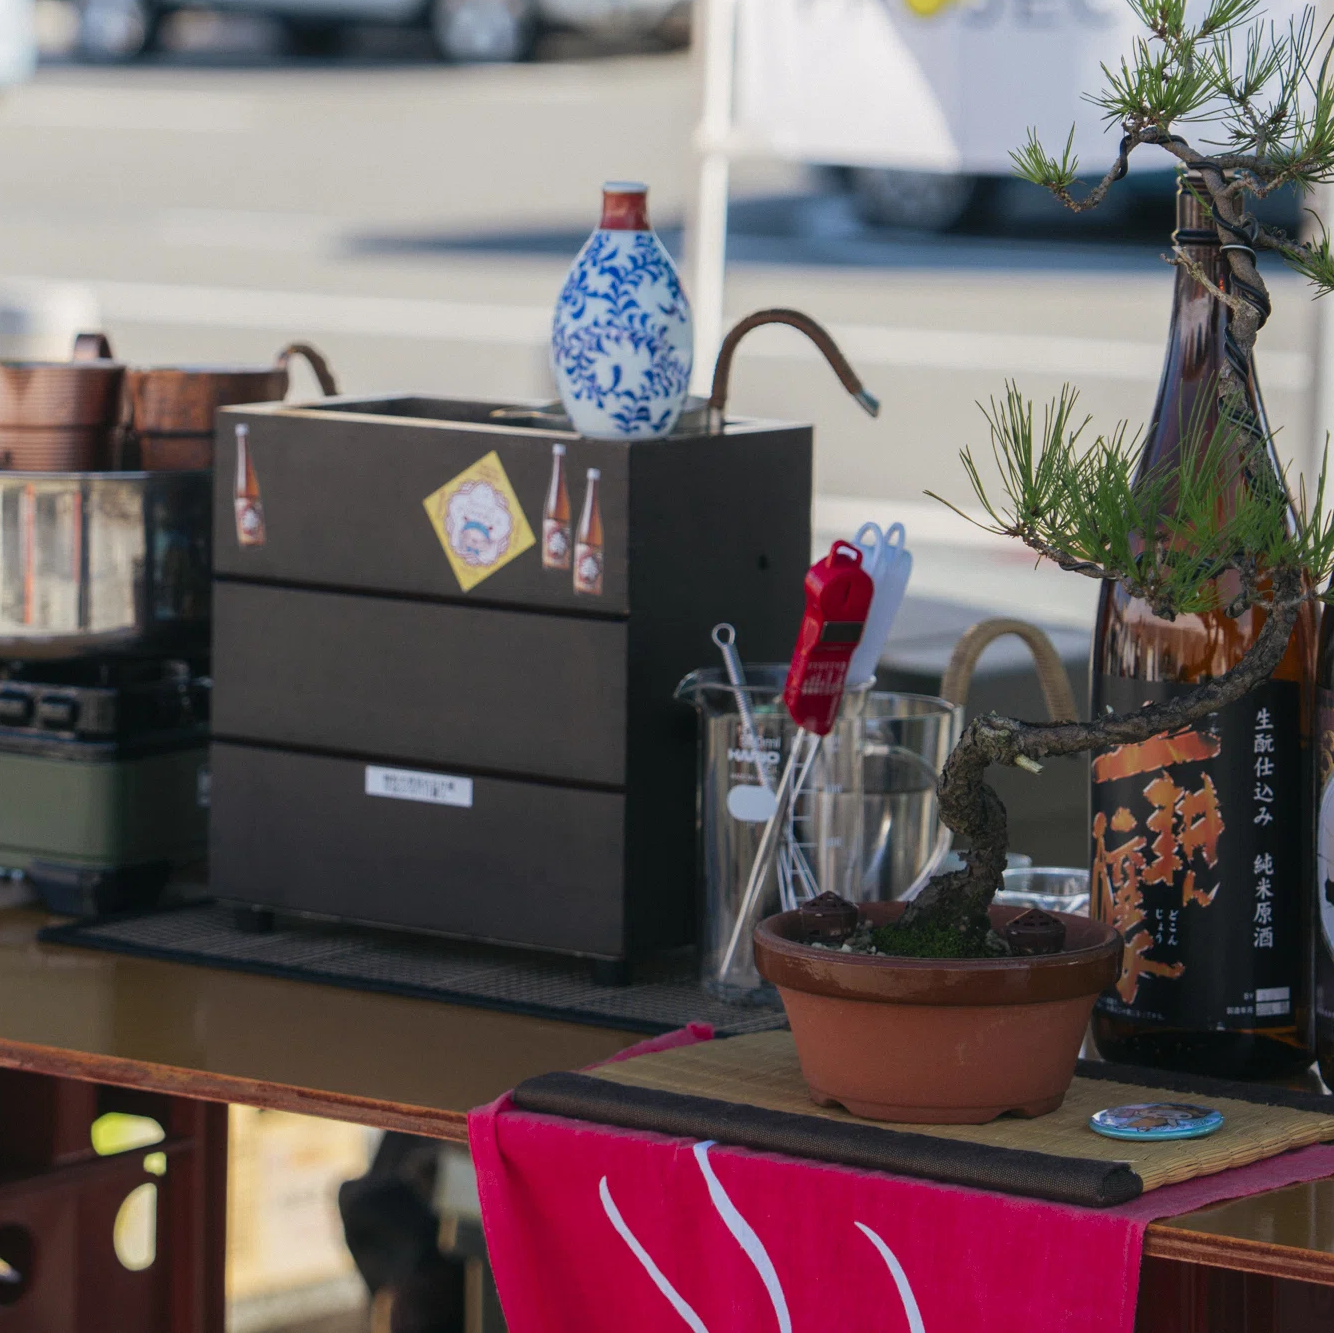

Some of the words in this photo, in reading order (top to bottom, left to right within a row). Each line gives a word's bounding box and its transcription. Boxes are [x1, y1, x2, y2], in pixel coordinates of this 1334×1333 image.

[727, 749, 781, 764] HAIO
[1253, 852, 1275, 949] 純米原酒
